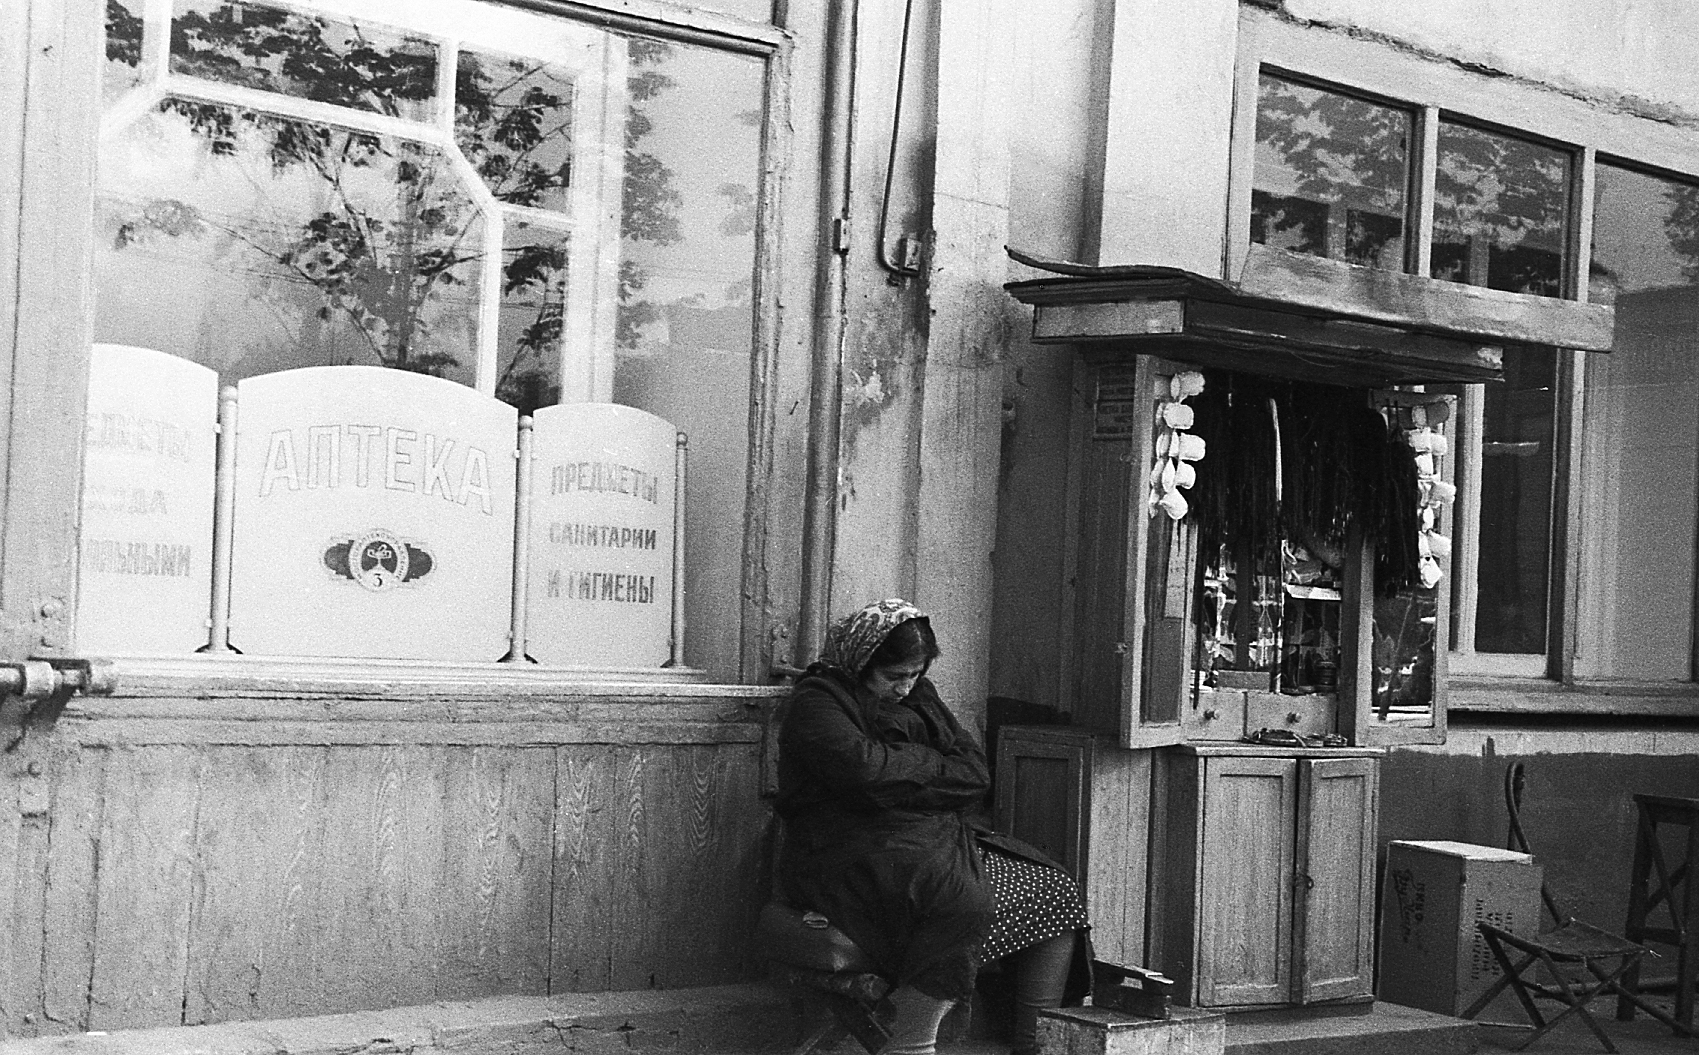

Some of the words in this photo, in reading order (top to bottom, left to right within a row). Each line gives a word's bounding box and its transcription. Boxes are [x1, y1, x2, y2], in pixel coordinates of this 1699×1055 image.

[259, 424, 493, 516] АПТЕКА
[551, 462, 658, 504] ПРЕДМЕТЫ
[549, 523, 656, 550] САНИТАРИИ
[547, 570, 560, 597] И
[568, 572, 655, 603] ГИГИЕНЫ
